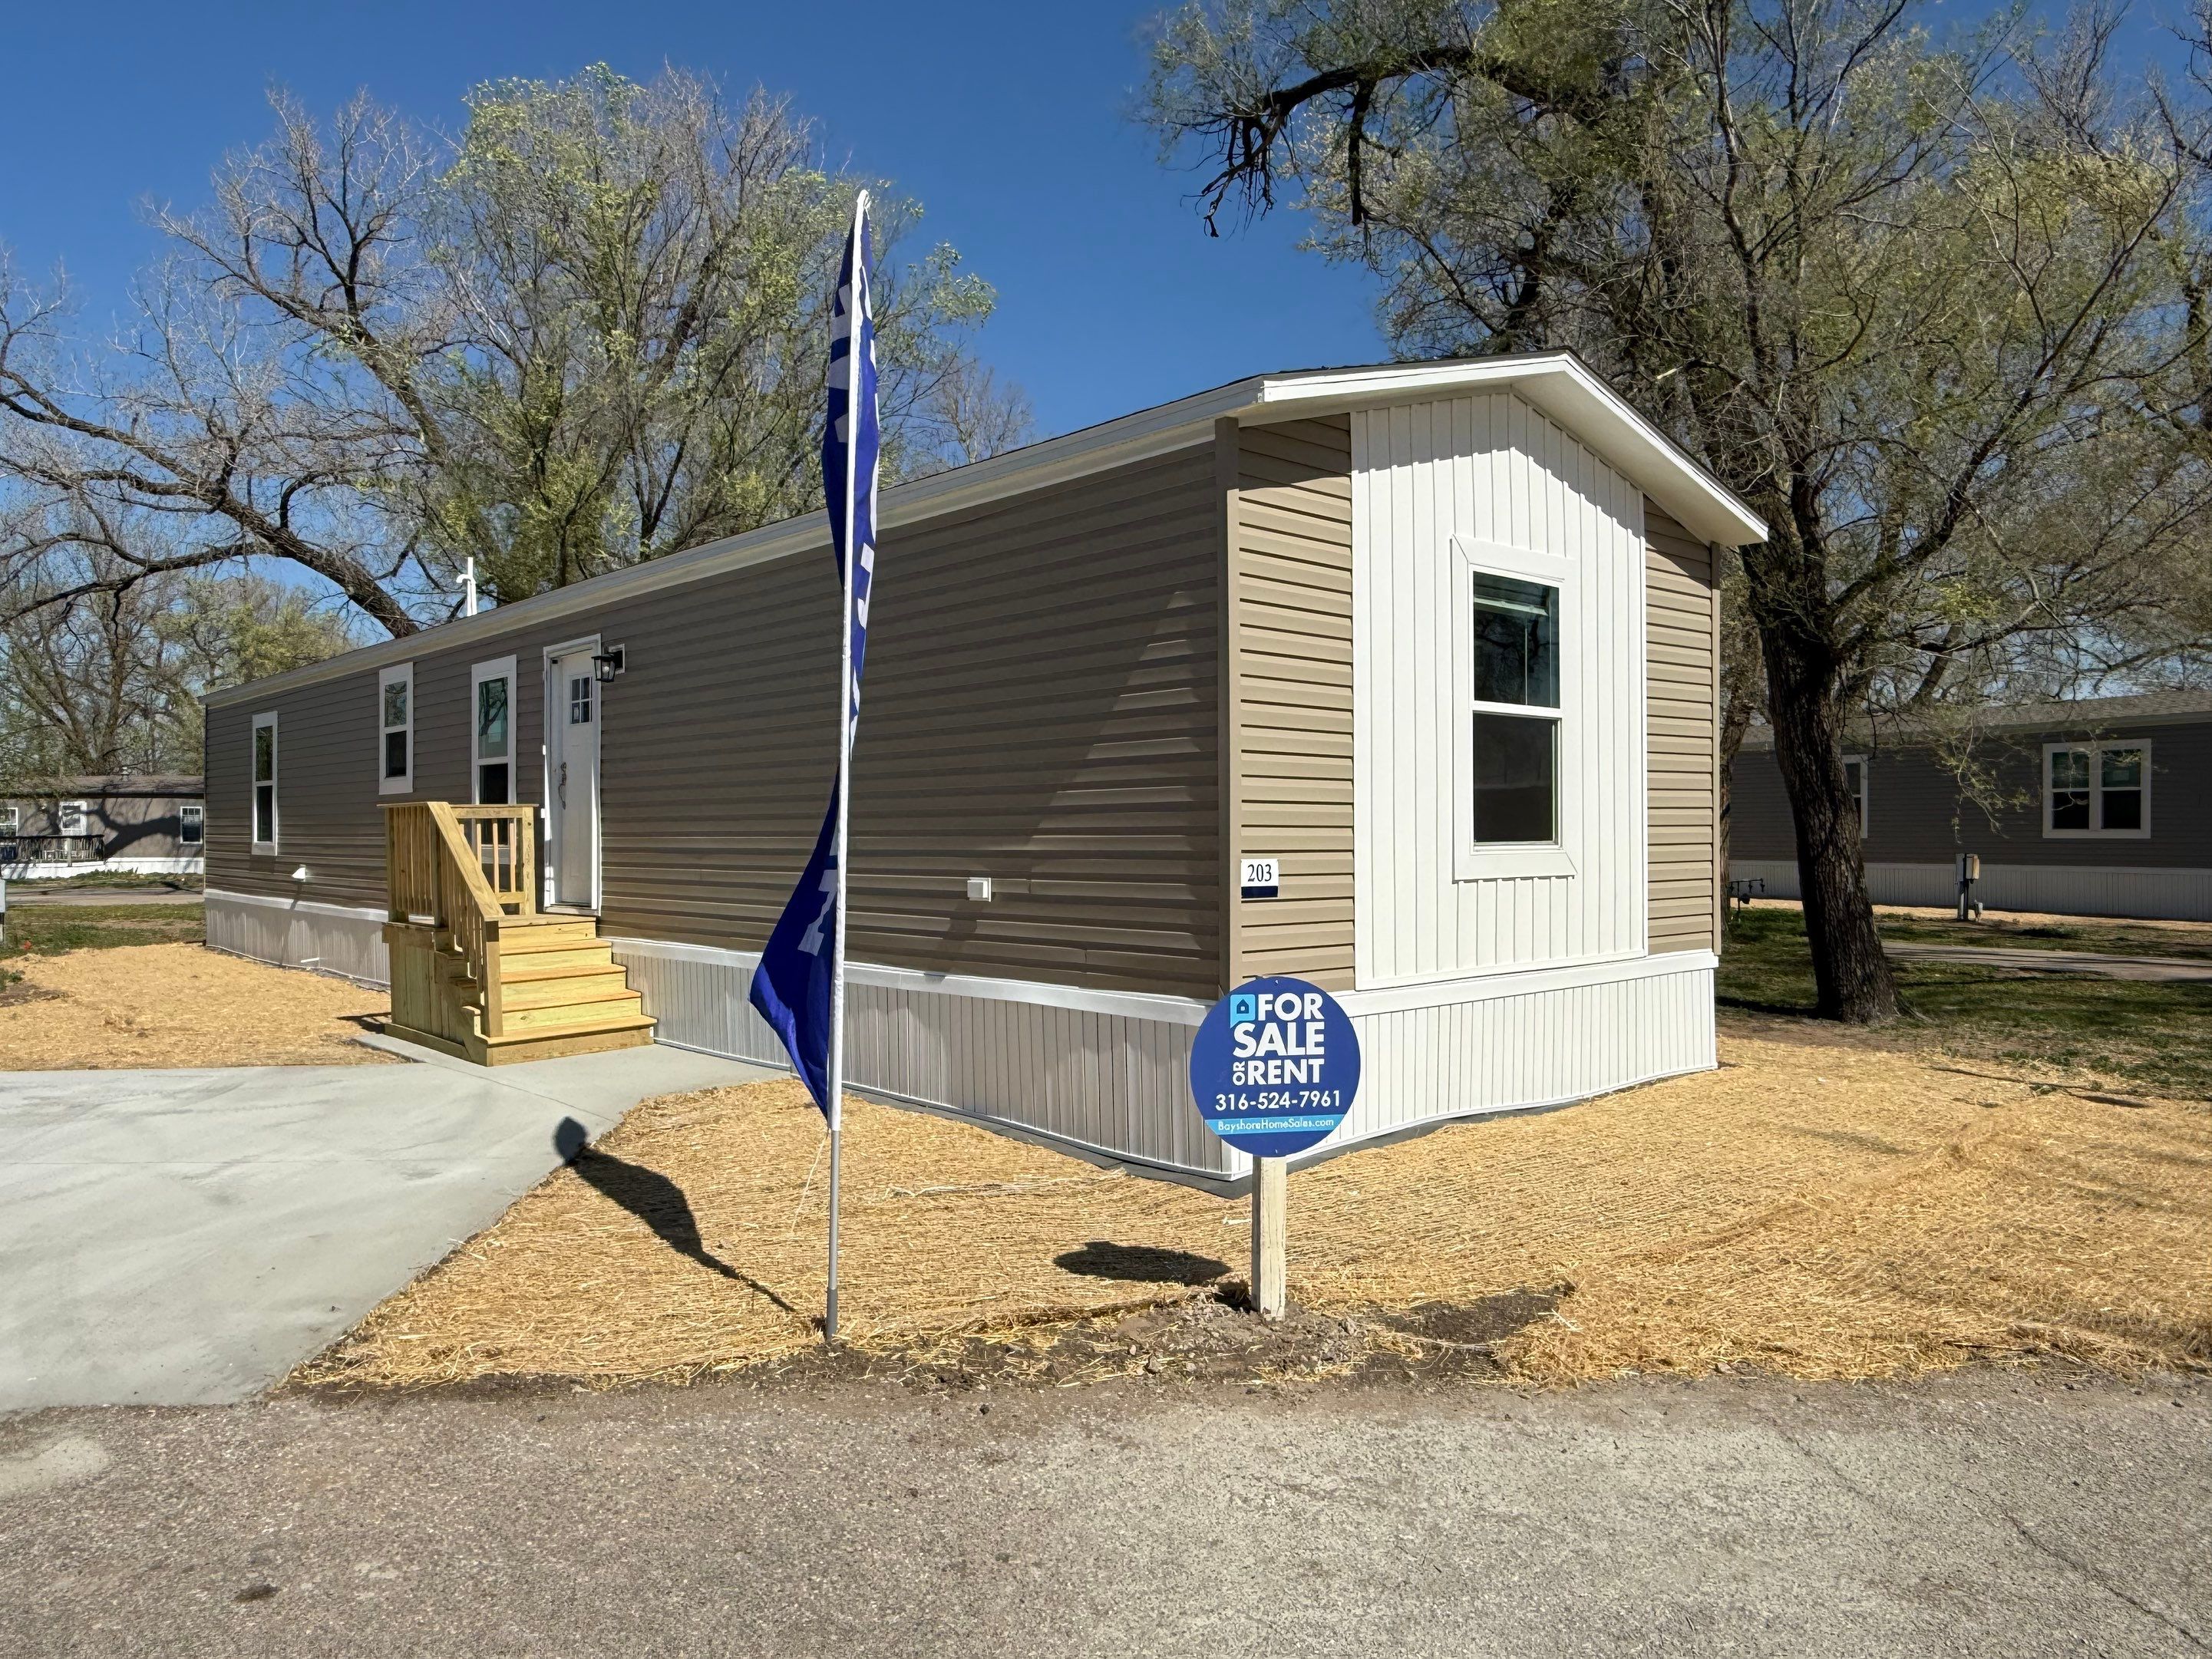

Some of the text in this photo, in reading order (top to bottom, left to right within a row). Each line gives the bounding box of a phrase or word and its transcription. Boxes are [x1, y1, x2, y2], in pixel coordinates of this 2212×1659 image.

[1247, 864, 1272, 882] 203
[1258, 993, 1325, 1021] FOR
[1233, 1021, 1325, 1058] SALE
[1233, 1058, 1325, 1086] OR RENT
[1215, 1090, 1339, 1111] 316-524-7961
[1218, 1119, 1334, 1132] BayshoreHomeSales.com
